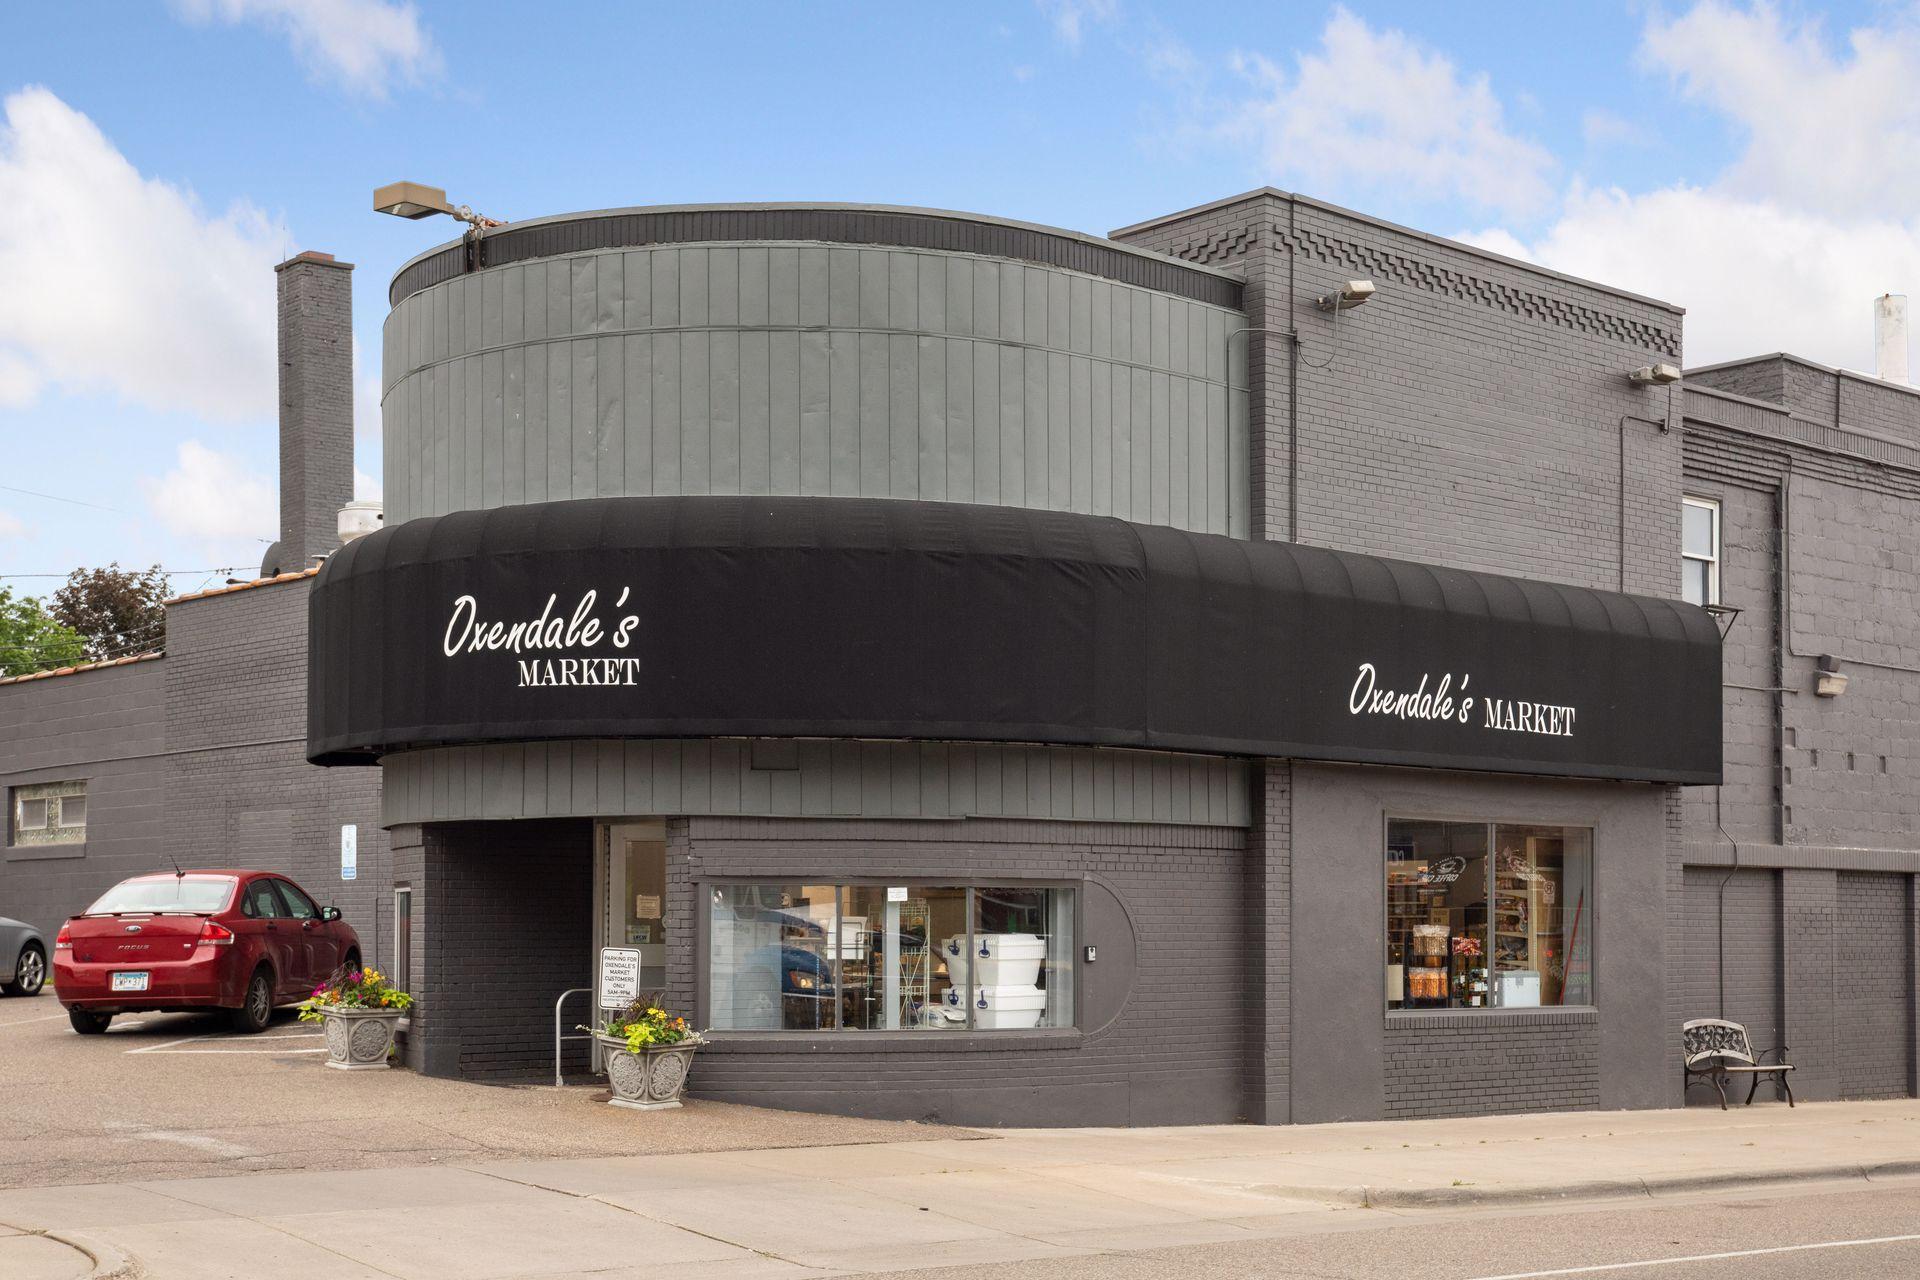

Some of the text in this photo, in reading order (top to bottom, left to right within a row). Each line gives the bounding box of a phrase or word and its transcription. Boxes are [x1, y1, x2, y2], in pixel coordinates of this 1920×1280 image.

[444, 586, 640, 657] Oxendale's
[517, 658, 640, 687] MARKET
[1349, 663, 1576, 736] Oxendale's MARKET
[604, 975, 635, 983] CUSTOMERS
